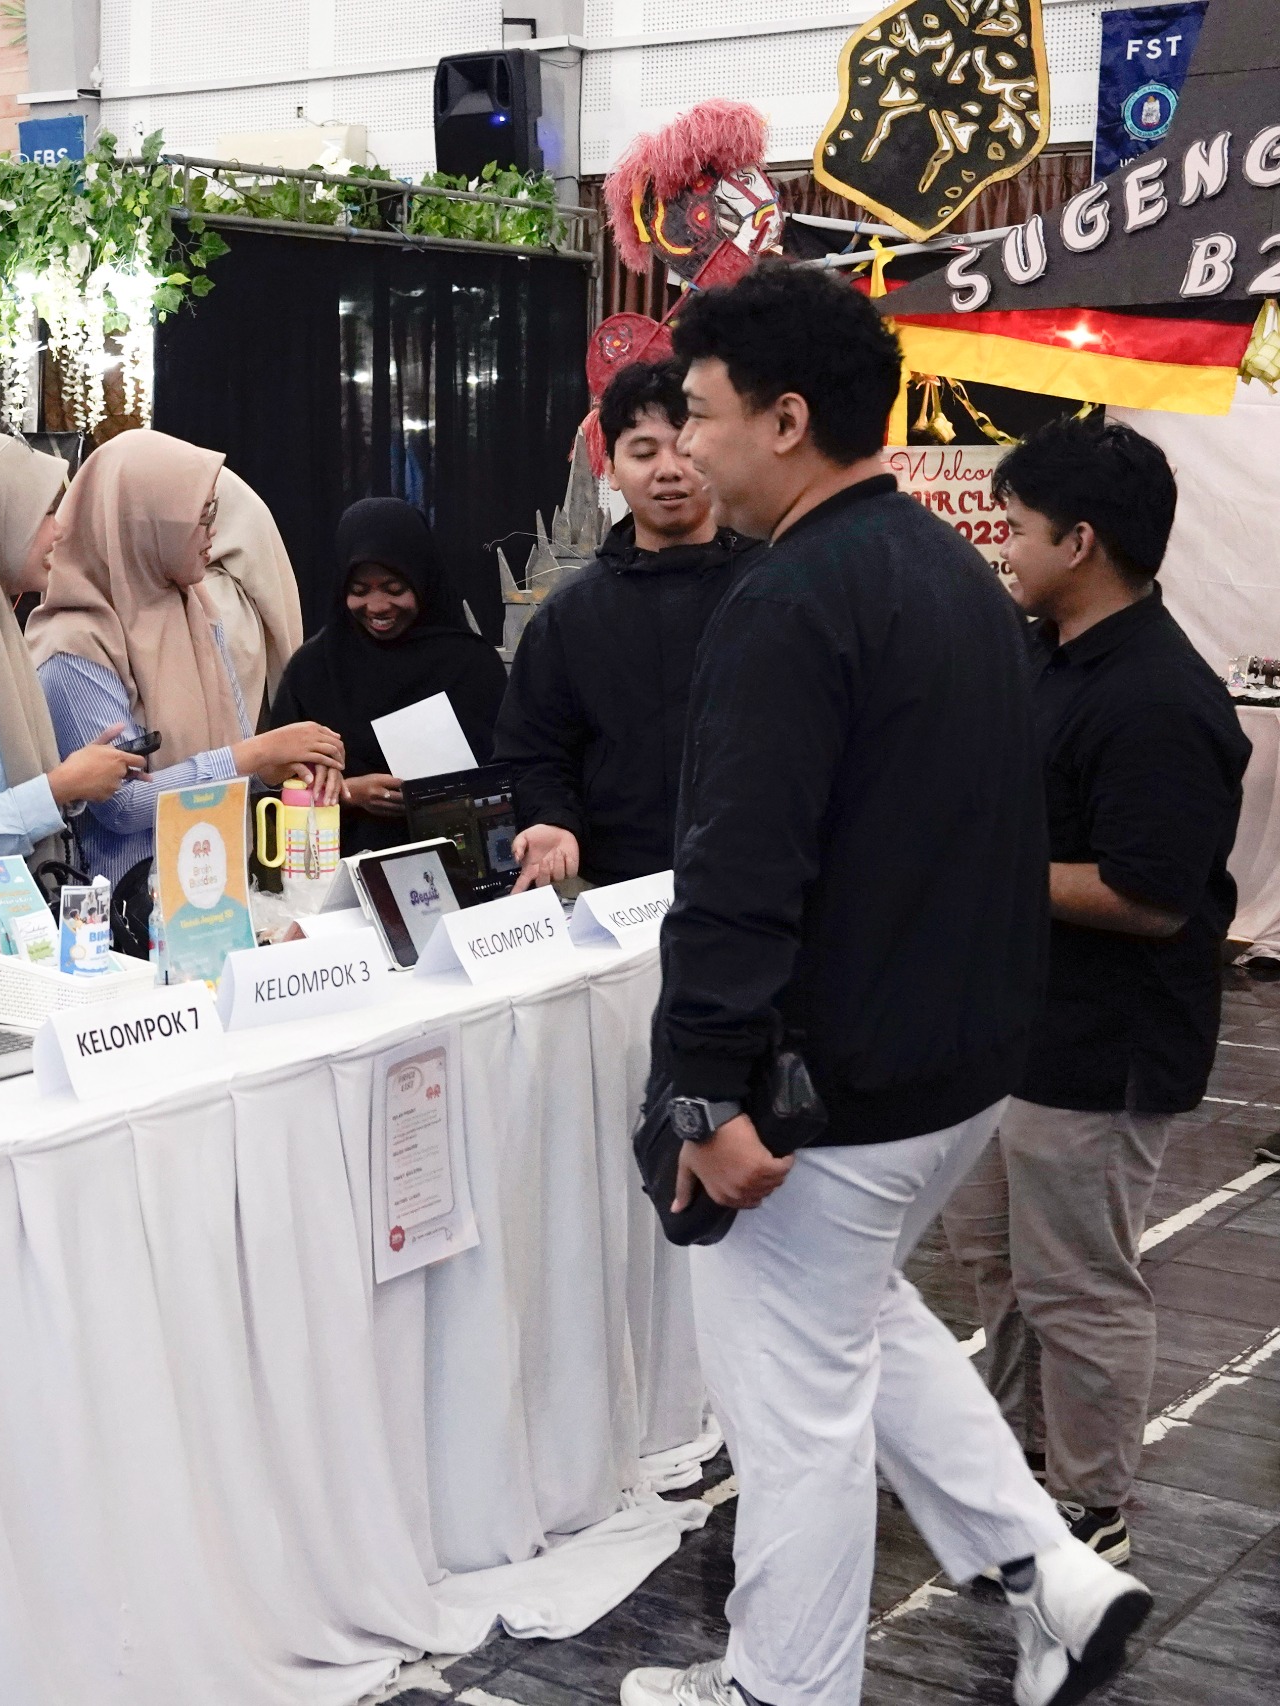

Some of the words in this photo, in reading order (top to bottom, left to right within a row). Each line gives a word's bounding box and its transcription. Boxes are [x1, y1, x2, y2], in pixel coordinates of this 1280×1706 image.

[1126, 35, 1183, 61] FST
[953, 520, 1010, 545] 023
[608, 898, 674, 929] KELOMPOK
[467, 920, 545, 960] KELOMPOK
[544, 917, 554, 938] 5
[254, 963, 355, 1004] KELOMPOK
[358, 960, 371, 982] 3
[76, 1010, 187, 1057] KELOMPOK
[187, 1007, 200, 1030] 7
